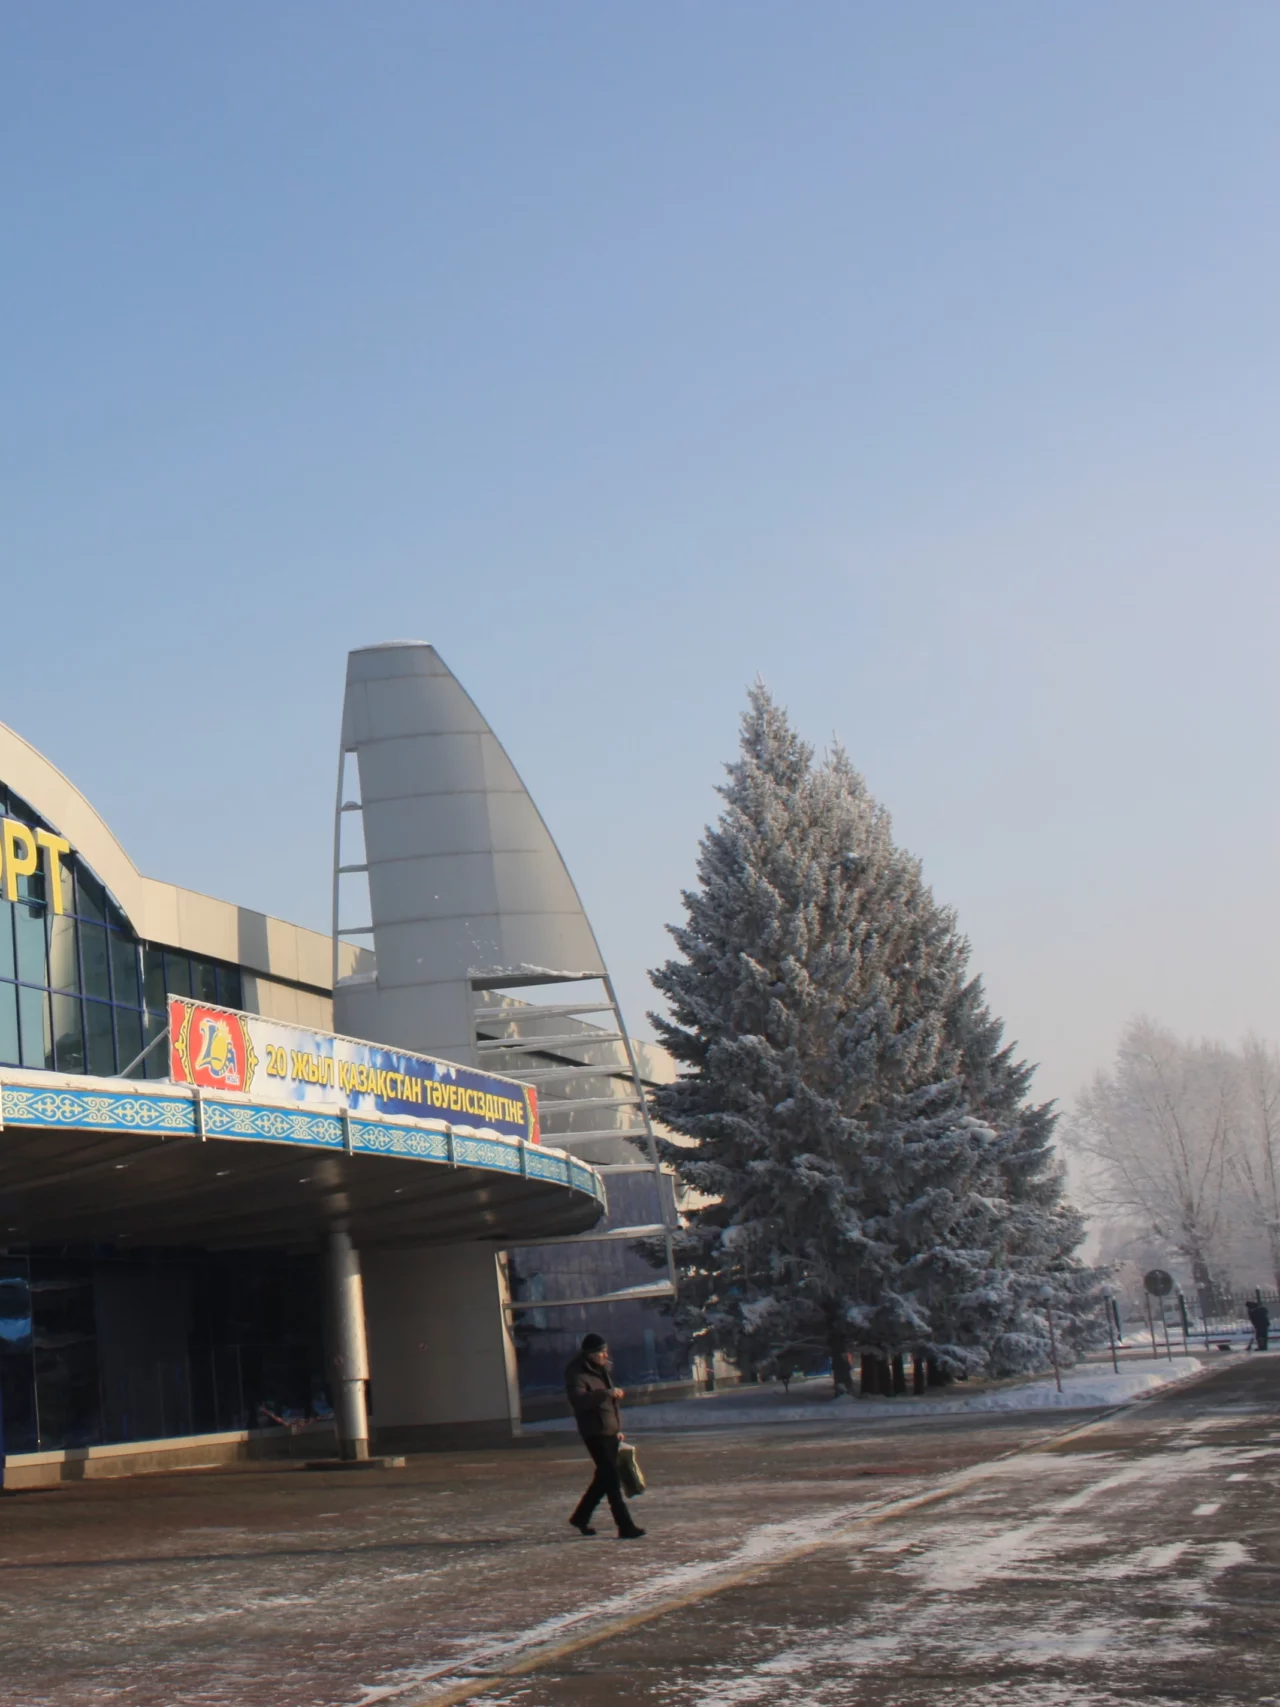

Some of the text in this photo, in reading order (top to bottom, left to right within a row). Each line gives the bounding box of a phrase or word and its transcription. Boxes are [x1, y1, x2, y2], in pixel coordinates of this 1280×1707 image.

[266, 1044, 287, 1078] 20
[291, 1050, 334, 1087] ЖЫЛ
[338, 1060, 422, 1103] ҚАЗАҚСТАН
